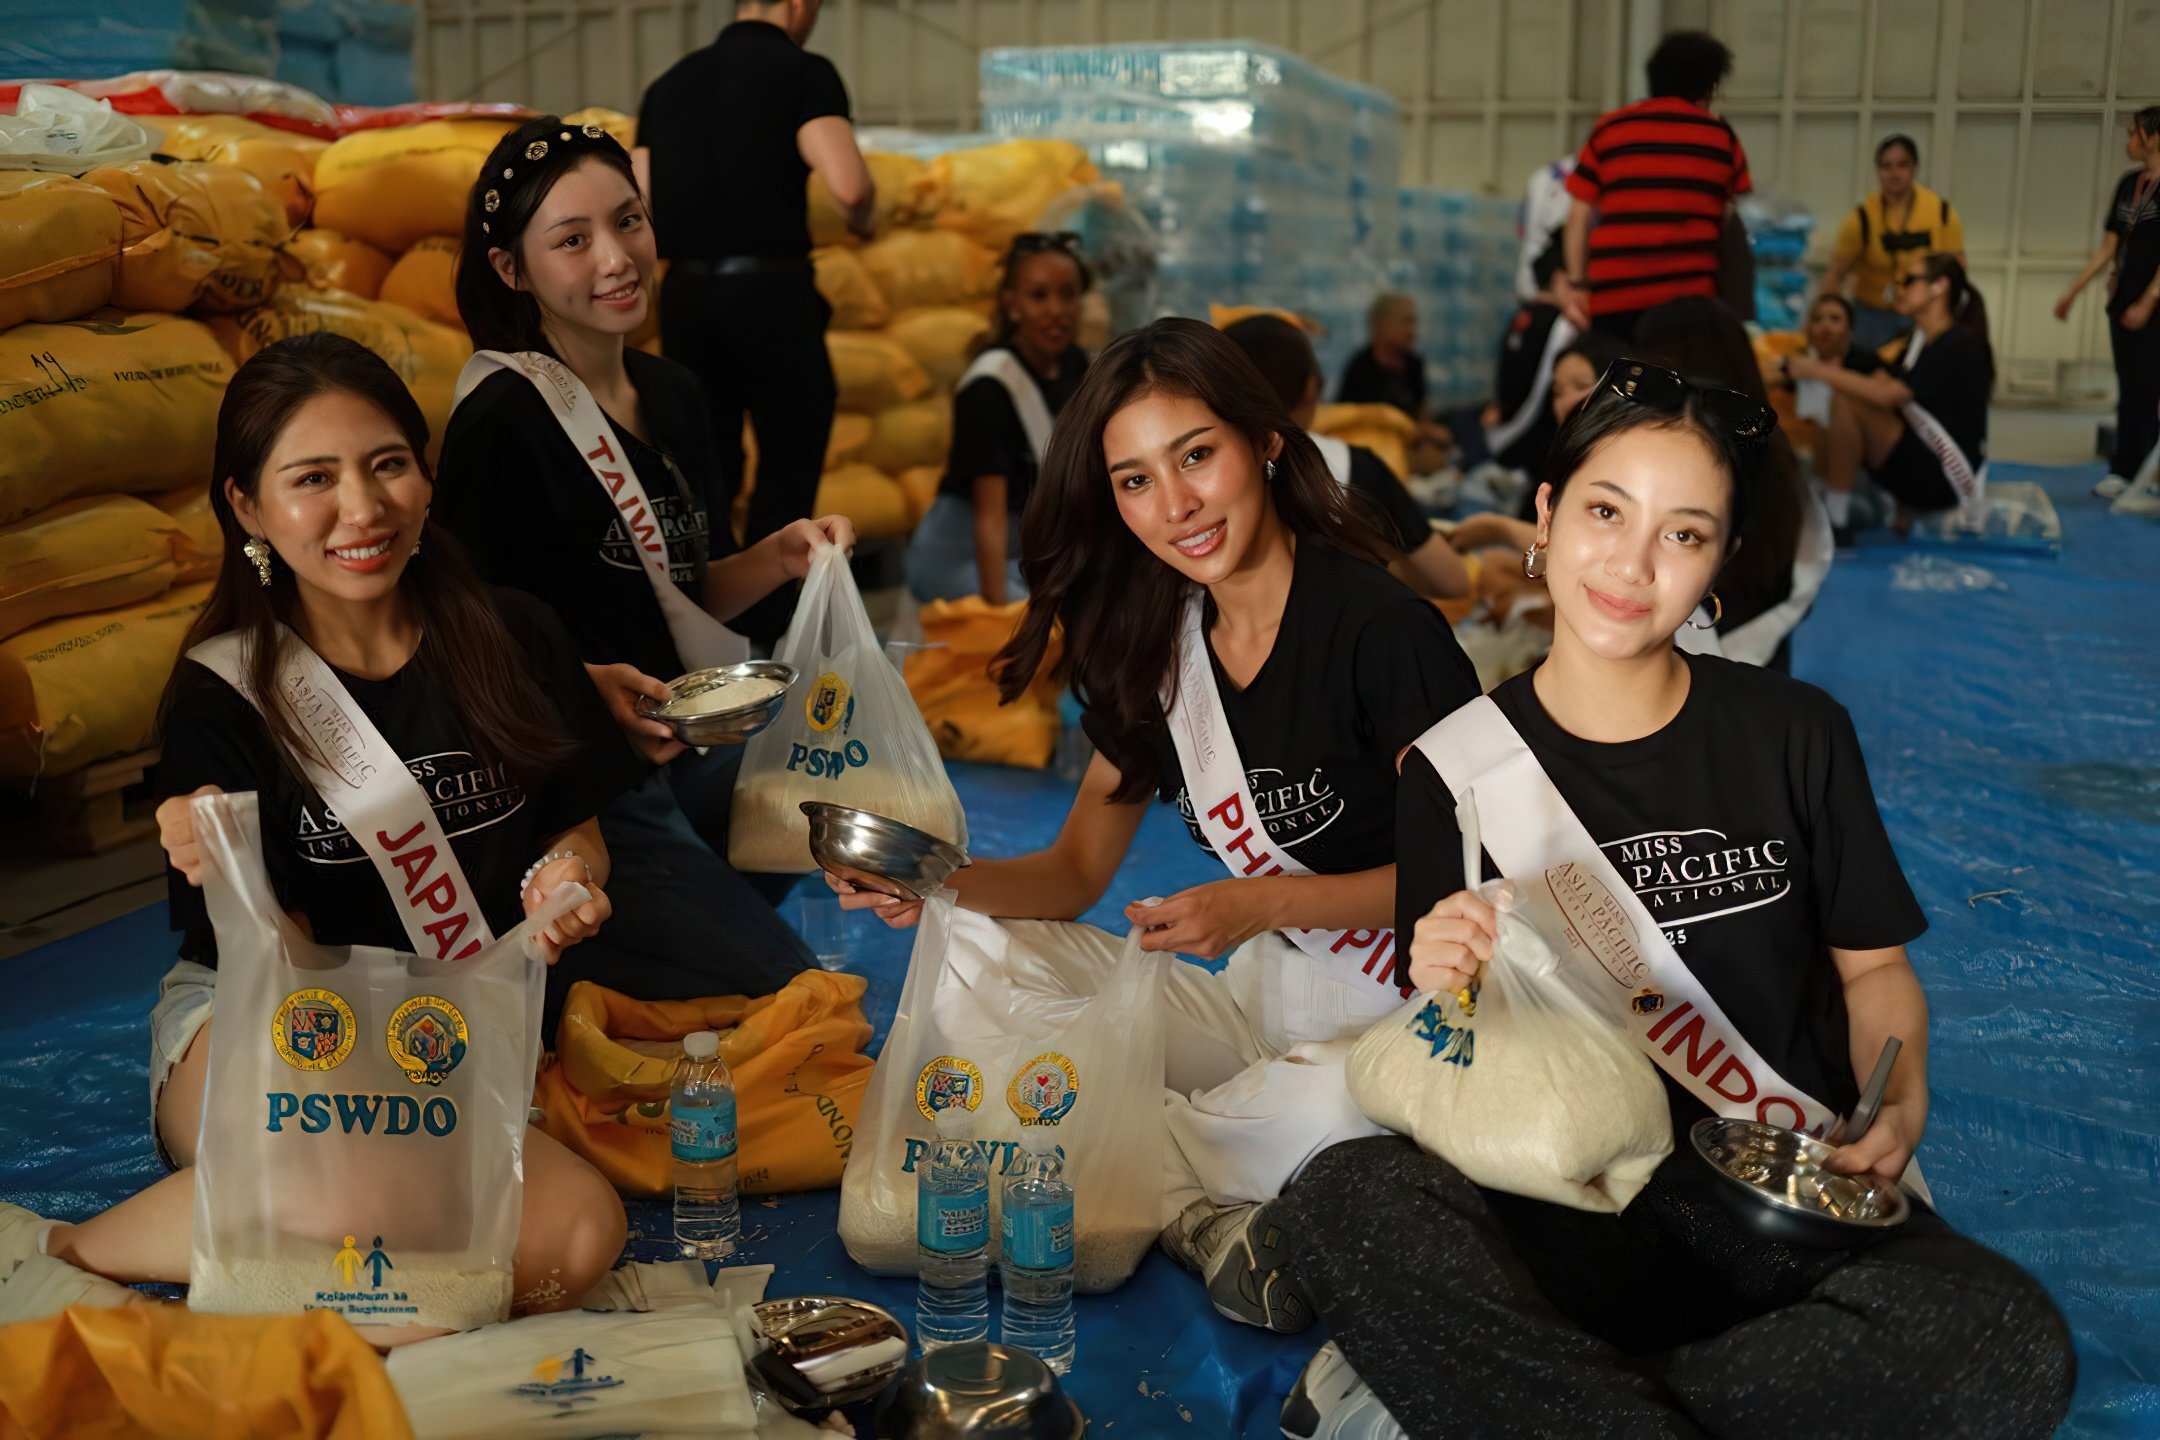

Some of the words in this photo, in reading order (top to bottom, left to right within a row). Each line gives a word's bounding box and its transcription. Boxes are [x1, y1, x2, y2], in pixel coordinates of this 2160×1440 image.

[587, 434, 664, 572] TAIW
[1620, 836, 1683, 863] MISS
[1632, 840, 1788, 888] PACIFIC
[1653, 875, 1781, 908] ATIONAL
[1645, 1001, 1824, 1139] INDO
[266, 1092, 458, 1137] PSWDO
